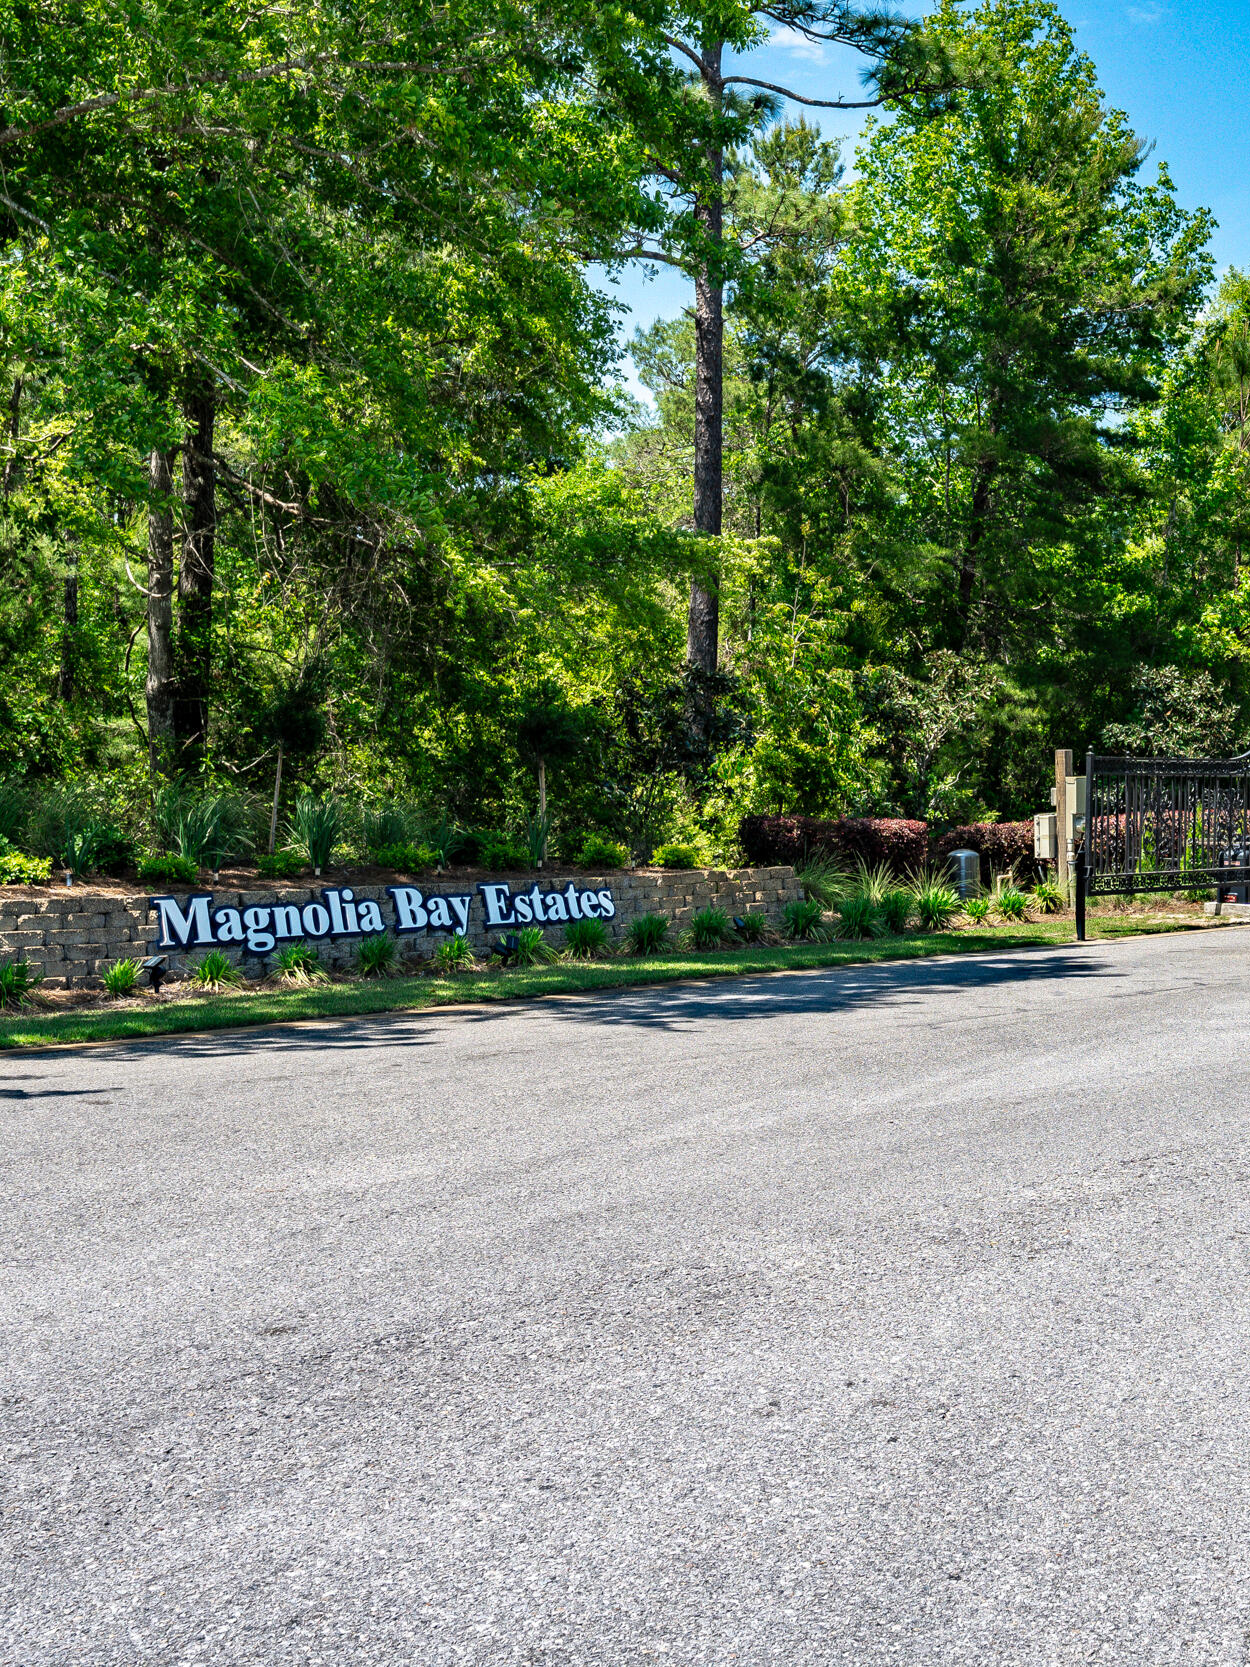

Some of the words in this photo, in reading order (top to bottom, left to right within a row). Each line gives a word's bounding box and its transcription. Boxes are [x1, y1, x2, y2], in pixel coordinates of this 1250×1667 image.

[154, 889, 385, 951] Magnolia
[390, 887, 471, 936] Bay
[480, 883, 615, 925] Estates
